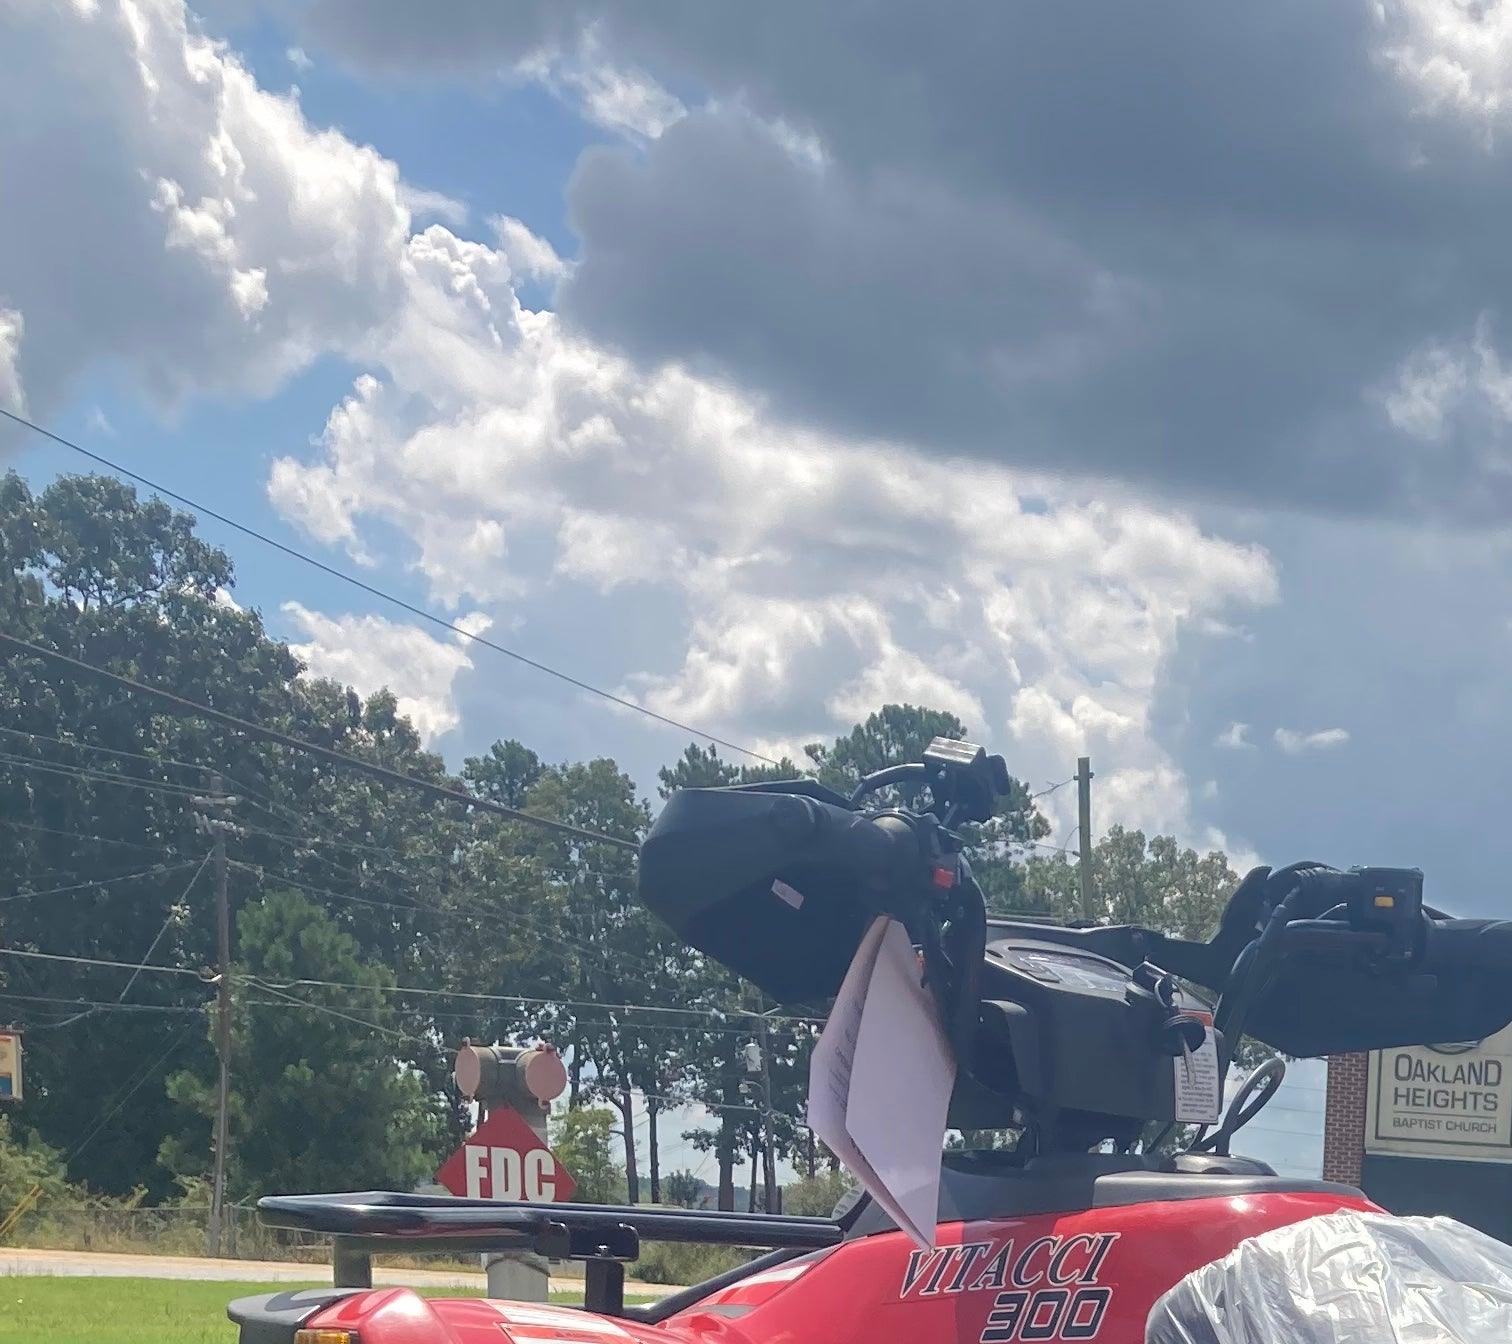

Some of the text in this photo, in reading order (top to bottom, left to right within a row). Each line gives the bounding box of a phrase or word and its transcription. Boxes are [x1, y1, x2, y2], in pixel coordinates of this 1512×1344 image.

[1394, 1053, 1502, 1087] OAKLAND
[1393, 1087, 1499, 1112] HEIGHTS
[1392, 1117, 1497, 1134] BAPTIST CHURCH
[465, 1144, 556, 1202] FDC
[900, 1232, 1122, 1299] VITACCI
[979, 1285, 1114, 1344] 300
